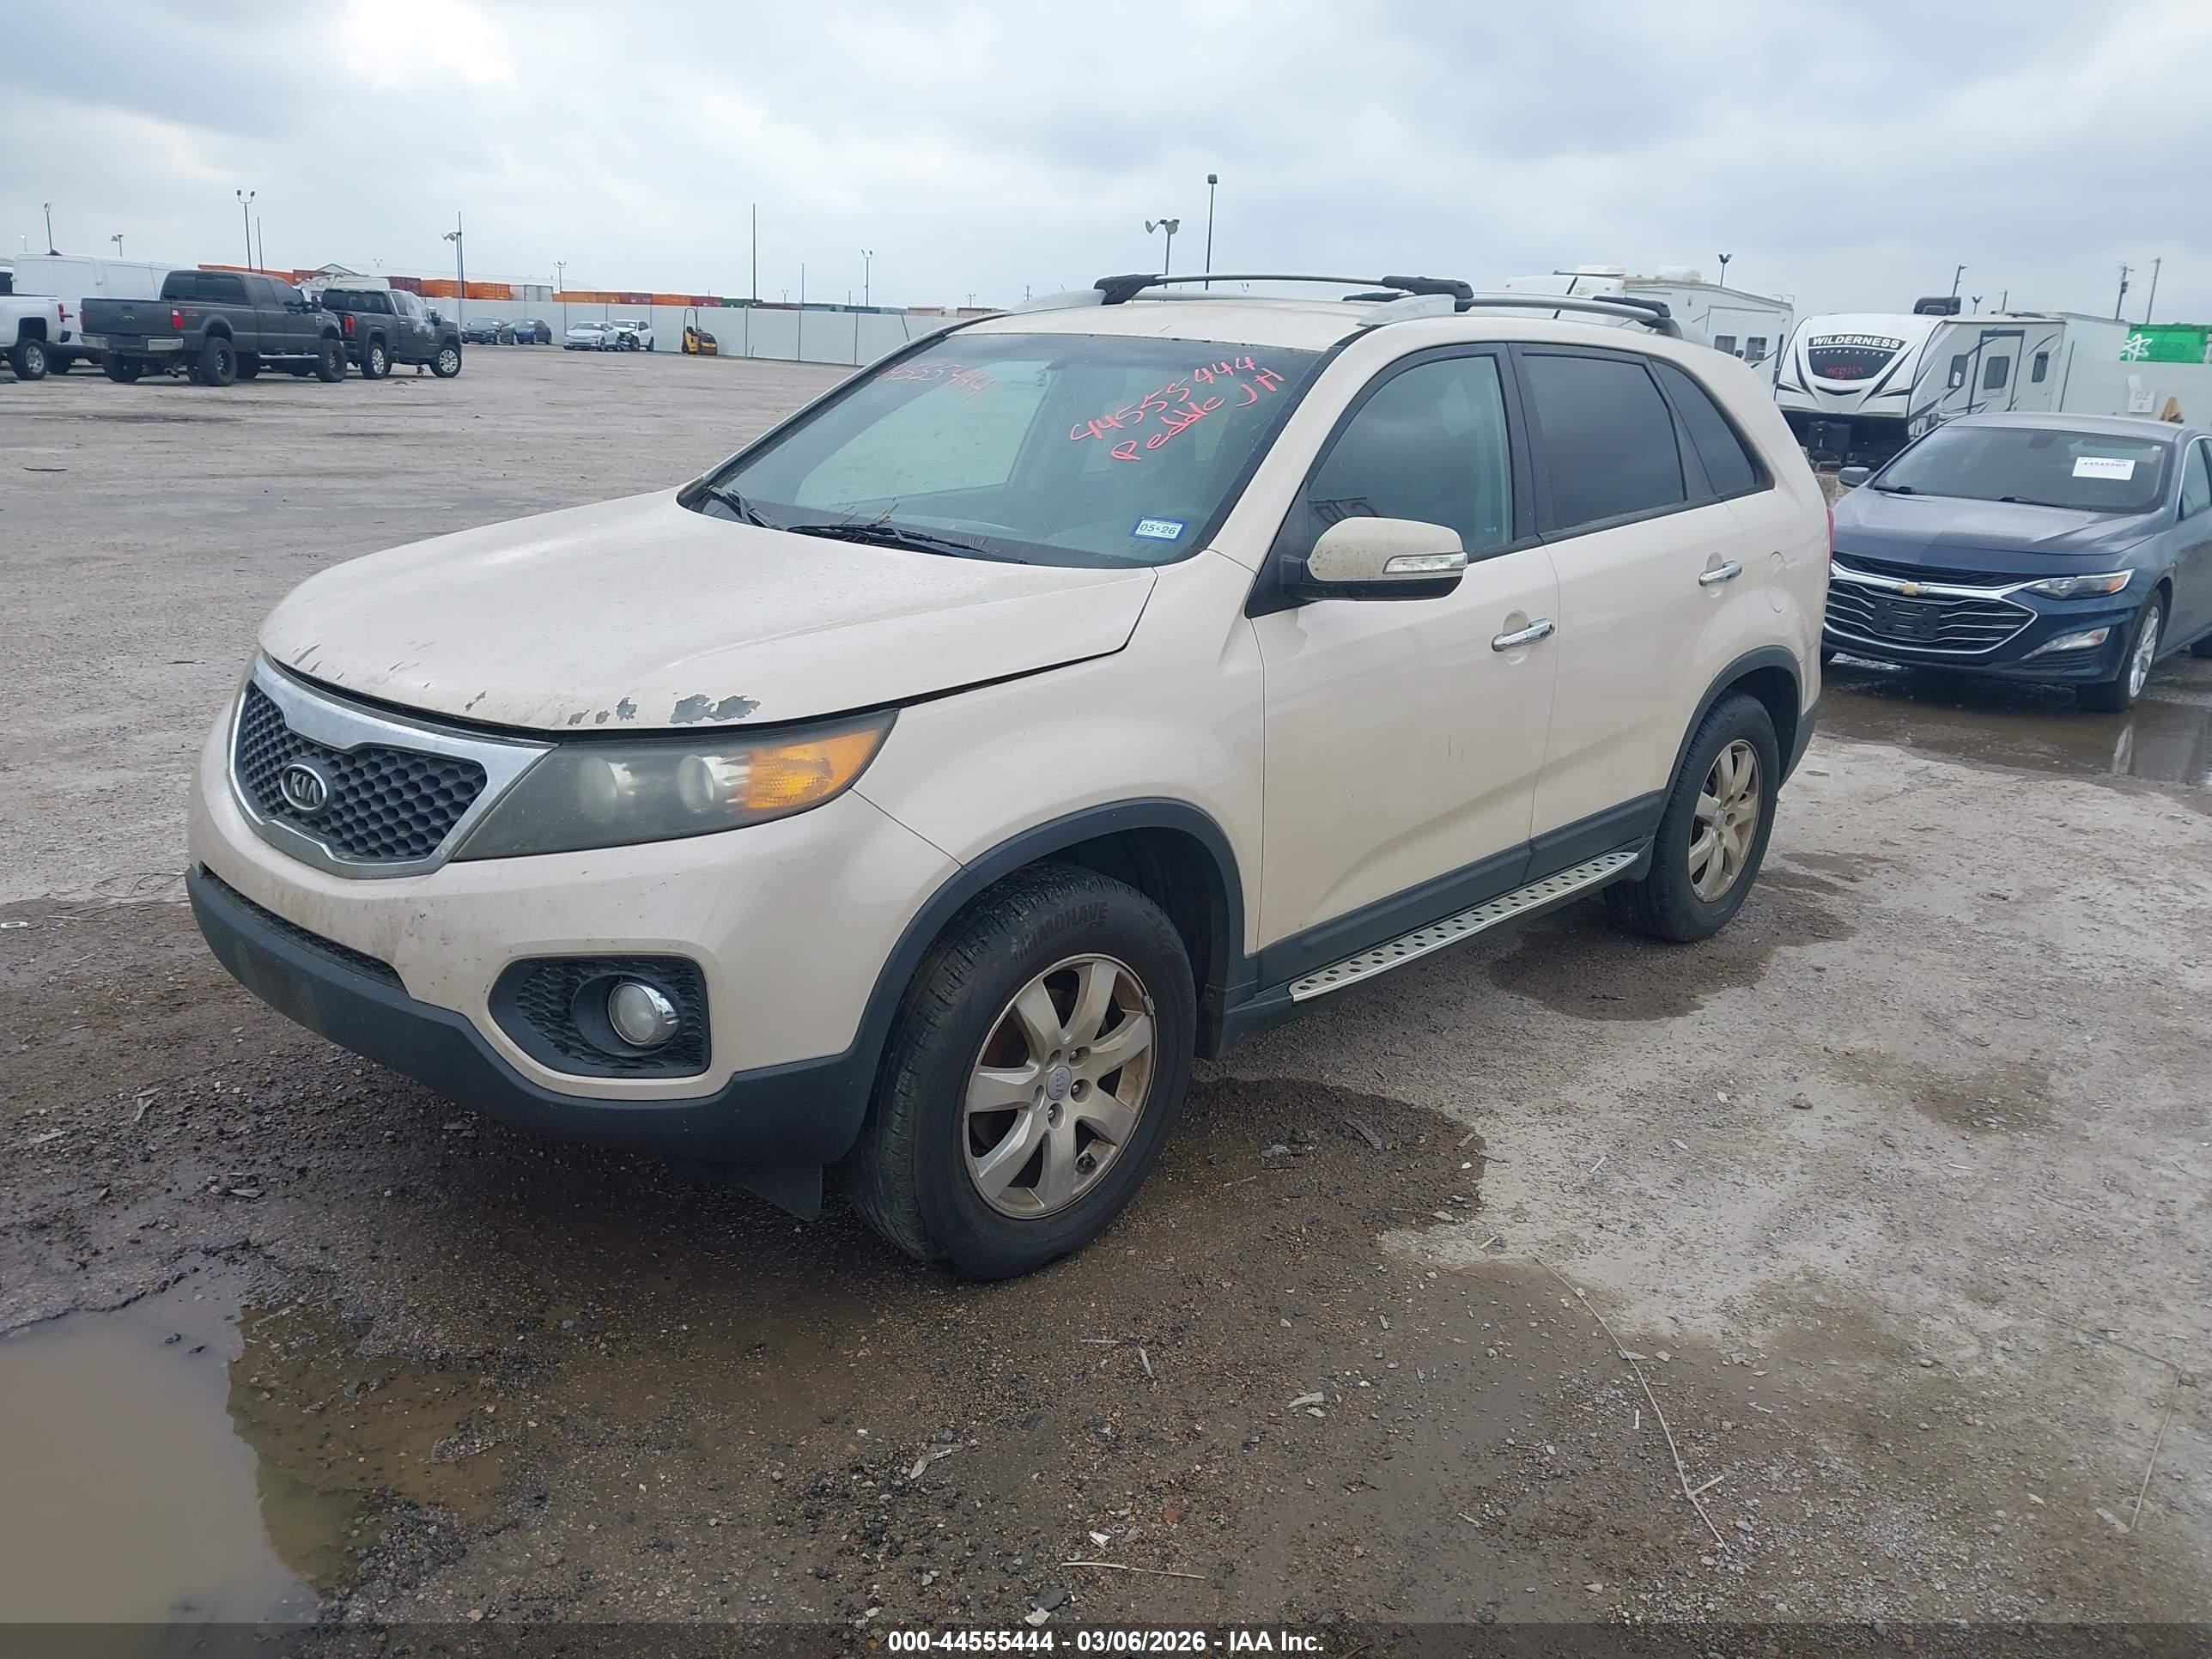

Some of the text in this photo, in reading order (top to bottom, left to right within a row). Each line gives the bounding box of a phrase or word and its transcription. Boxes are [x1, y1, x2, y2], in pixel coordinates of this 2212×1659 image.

[1813, 336, 1900, 349] WILDERNESS
[1070, 356, 1255, 441] 44555444
[290, 771, 320, 805] KIA
